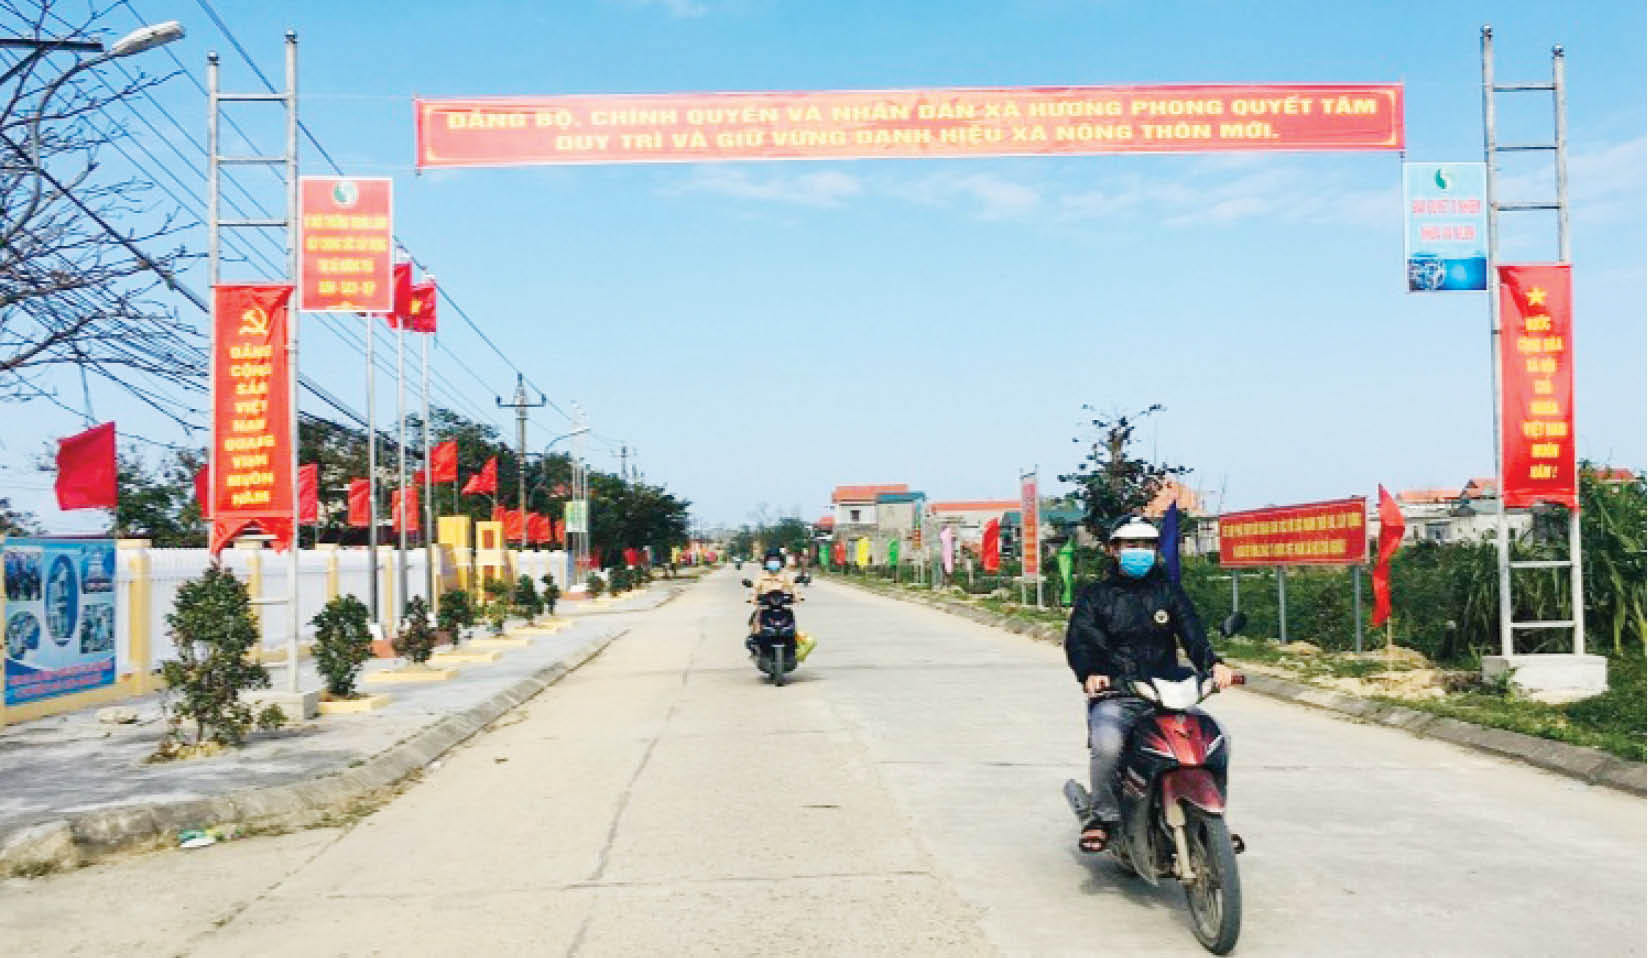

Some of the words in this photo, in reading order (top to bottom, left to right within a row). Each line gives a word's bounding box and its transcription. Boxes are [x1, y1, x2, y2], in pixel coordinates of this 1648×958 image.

[591, 108, 676, 127] CHÍNH
[687, 105, 779, 126] QUYỀN
[786, 105, 821, 122] VÀ
[832, 102, 909, 122] NHÂN
[1029, 100, 1123, 118] HƯƠNG
[1131, 98, 1224, 117] PHONG
[1232, 94, 1312, 116] QUYẾT
[1321, 95, 1377, 115] TÂM
[556, 134, 609, 151] DUY
[622, 131, 664, 150] TRÌ
[672, 129, 708, 148] VÀ
[939, 125, 1003, 144] HIỆU
[1056, 122, 1133, 141] NÔNG
[1141, 121, 1212, 140] THÔN
